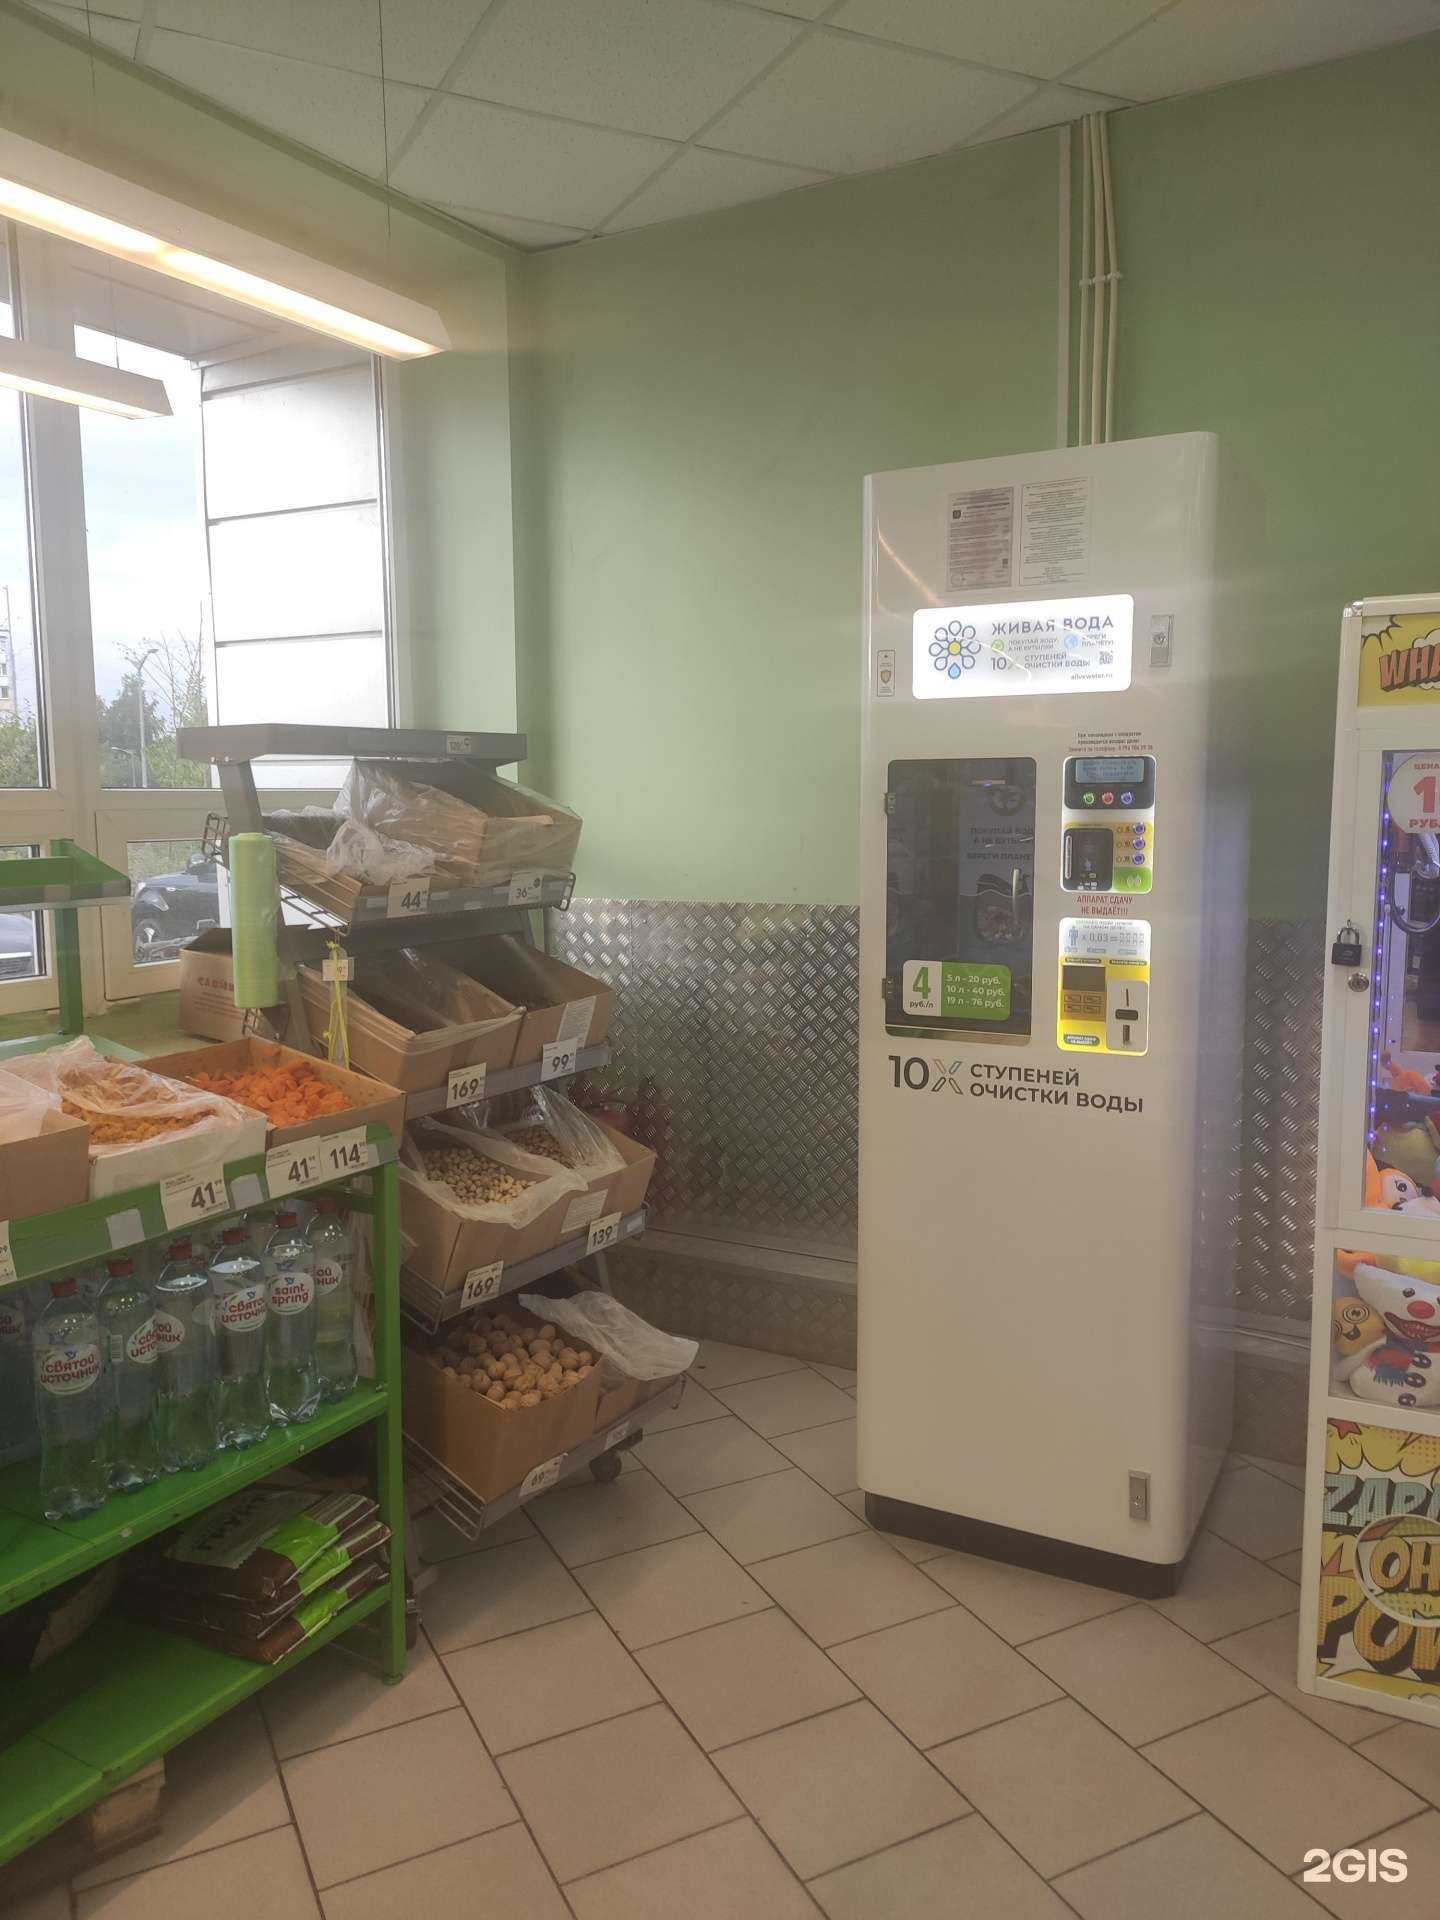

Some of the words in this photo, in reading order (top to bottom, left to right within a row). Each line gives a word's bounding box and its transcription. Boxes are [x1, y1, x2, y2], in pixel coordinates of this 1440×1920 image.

[992, 620, 1055, 635] ЖИВАЯ
[1064, 616, 1114, 631] ВОДА
[1025, 652, 1067, 661] СТУПЕНЕЙ
[1025, 661, 1063, 669] ОЧИСТКИ
[1065, 659, 1090, 667] ВОДЫ
[1413, 776, 1440, 813] 1
[1409, 819, 1440, 829] РУБ
[400, 891, 421, 909] 44
[516, 888, 528, 898] 36
[1077, 895, 1108, 904] АППАРАТ
[1110, 896, 1132, 905] СДАЧУ
[912, 966, 931, 999] 4
[968, 975, 980, 983] 20
[982, 976, 1001, 986] руб.
[946, 984, 957, 993] 10
[986, 987, 1006, 997] руб.
[984, 999, 1005, 1009] руб.
[551, 1054, 570, 1072] 99
[970, 1063, 1080, 1086] СТУПЕНЕЙ
[451, 1078, 479, 1100] 169
[970, 1083, 1068, 1105] ОЧИСТКИ
[1076, 1092, 1143, 1114] ВОДЫ
[329, 1143, 361, 1170] 114
[288, 1158, 310, 1183] 41
[191, 1181, 216, 1209] 41
[592, 1226, 613, 1247] 139
[275, 1283, 305, 1295] saint
[467, 1277, 494, 1300] 169
[272, 1292, 309, 1307] spring
[45, 1353, 96, 1374] СВЯТОЙ
